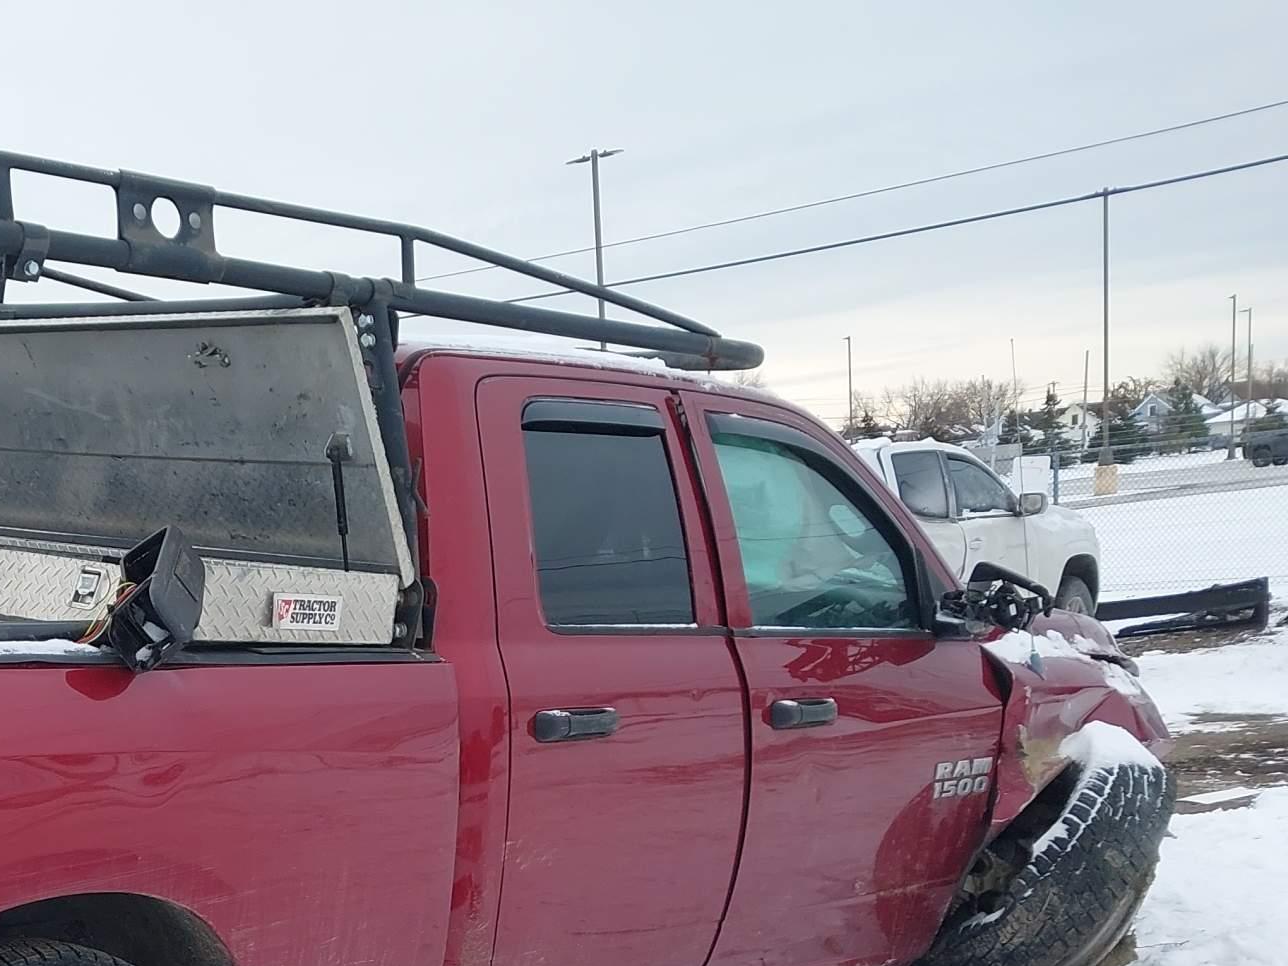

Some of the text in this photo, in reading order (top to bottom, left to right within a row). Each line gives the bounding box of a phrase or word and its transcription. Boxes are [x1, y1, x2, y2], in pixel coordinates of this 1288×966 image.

[293, 600, 337, 612] TRACTOR
[290, 612, 324, 625] SUPPLY
[935, 756, 993, 780] RAM
[933, 775, 990, 800] 1500
